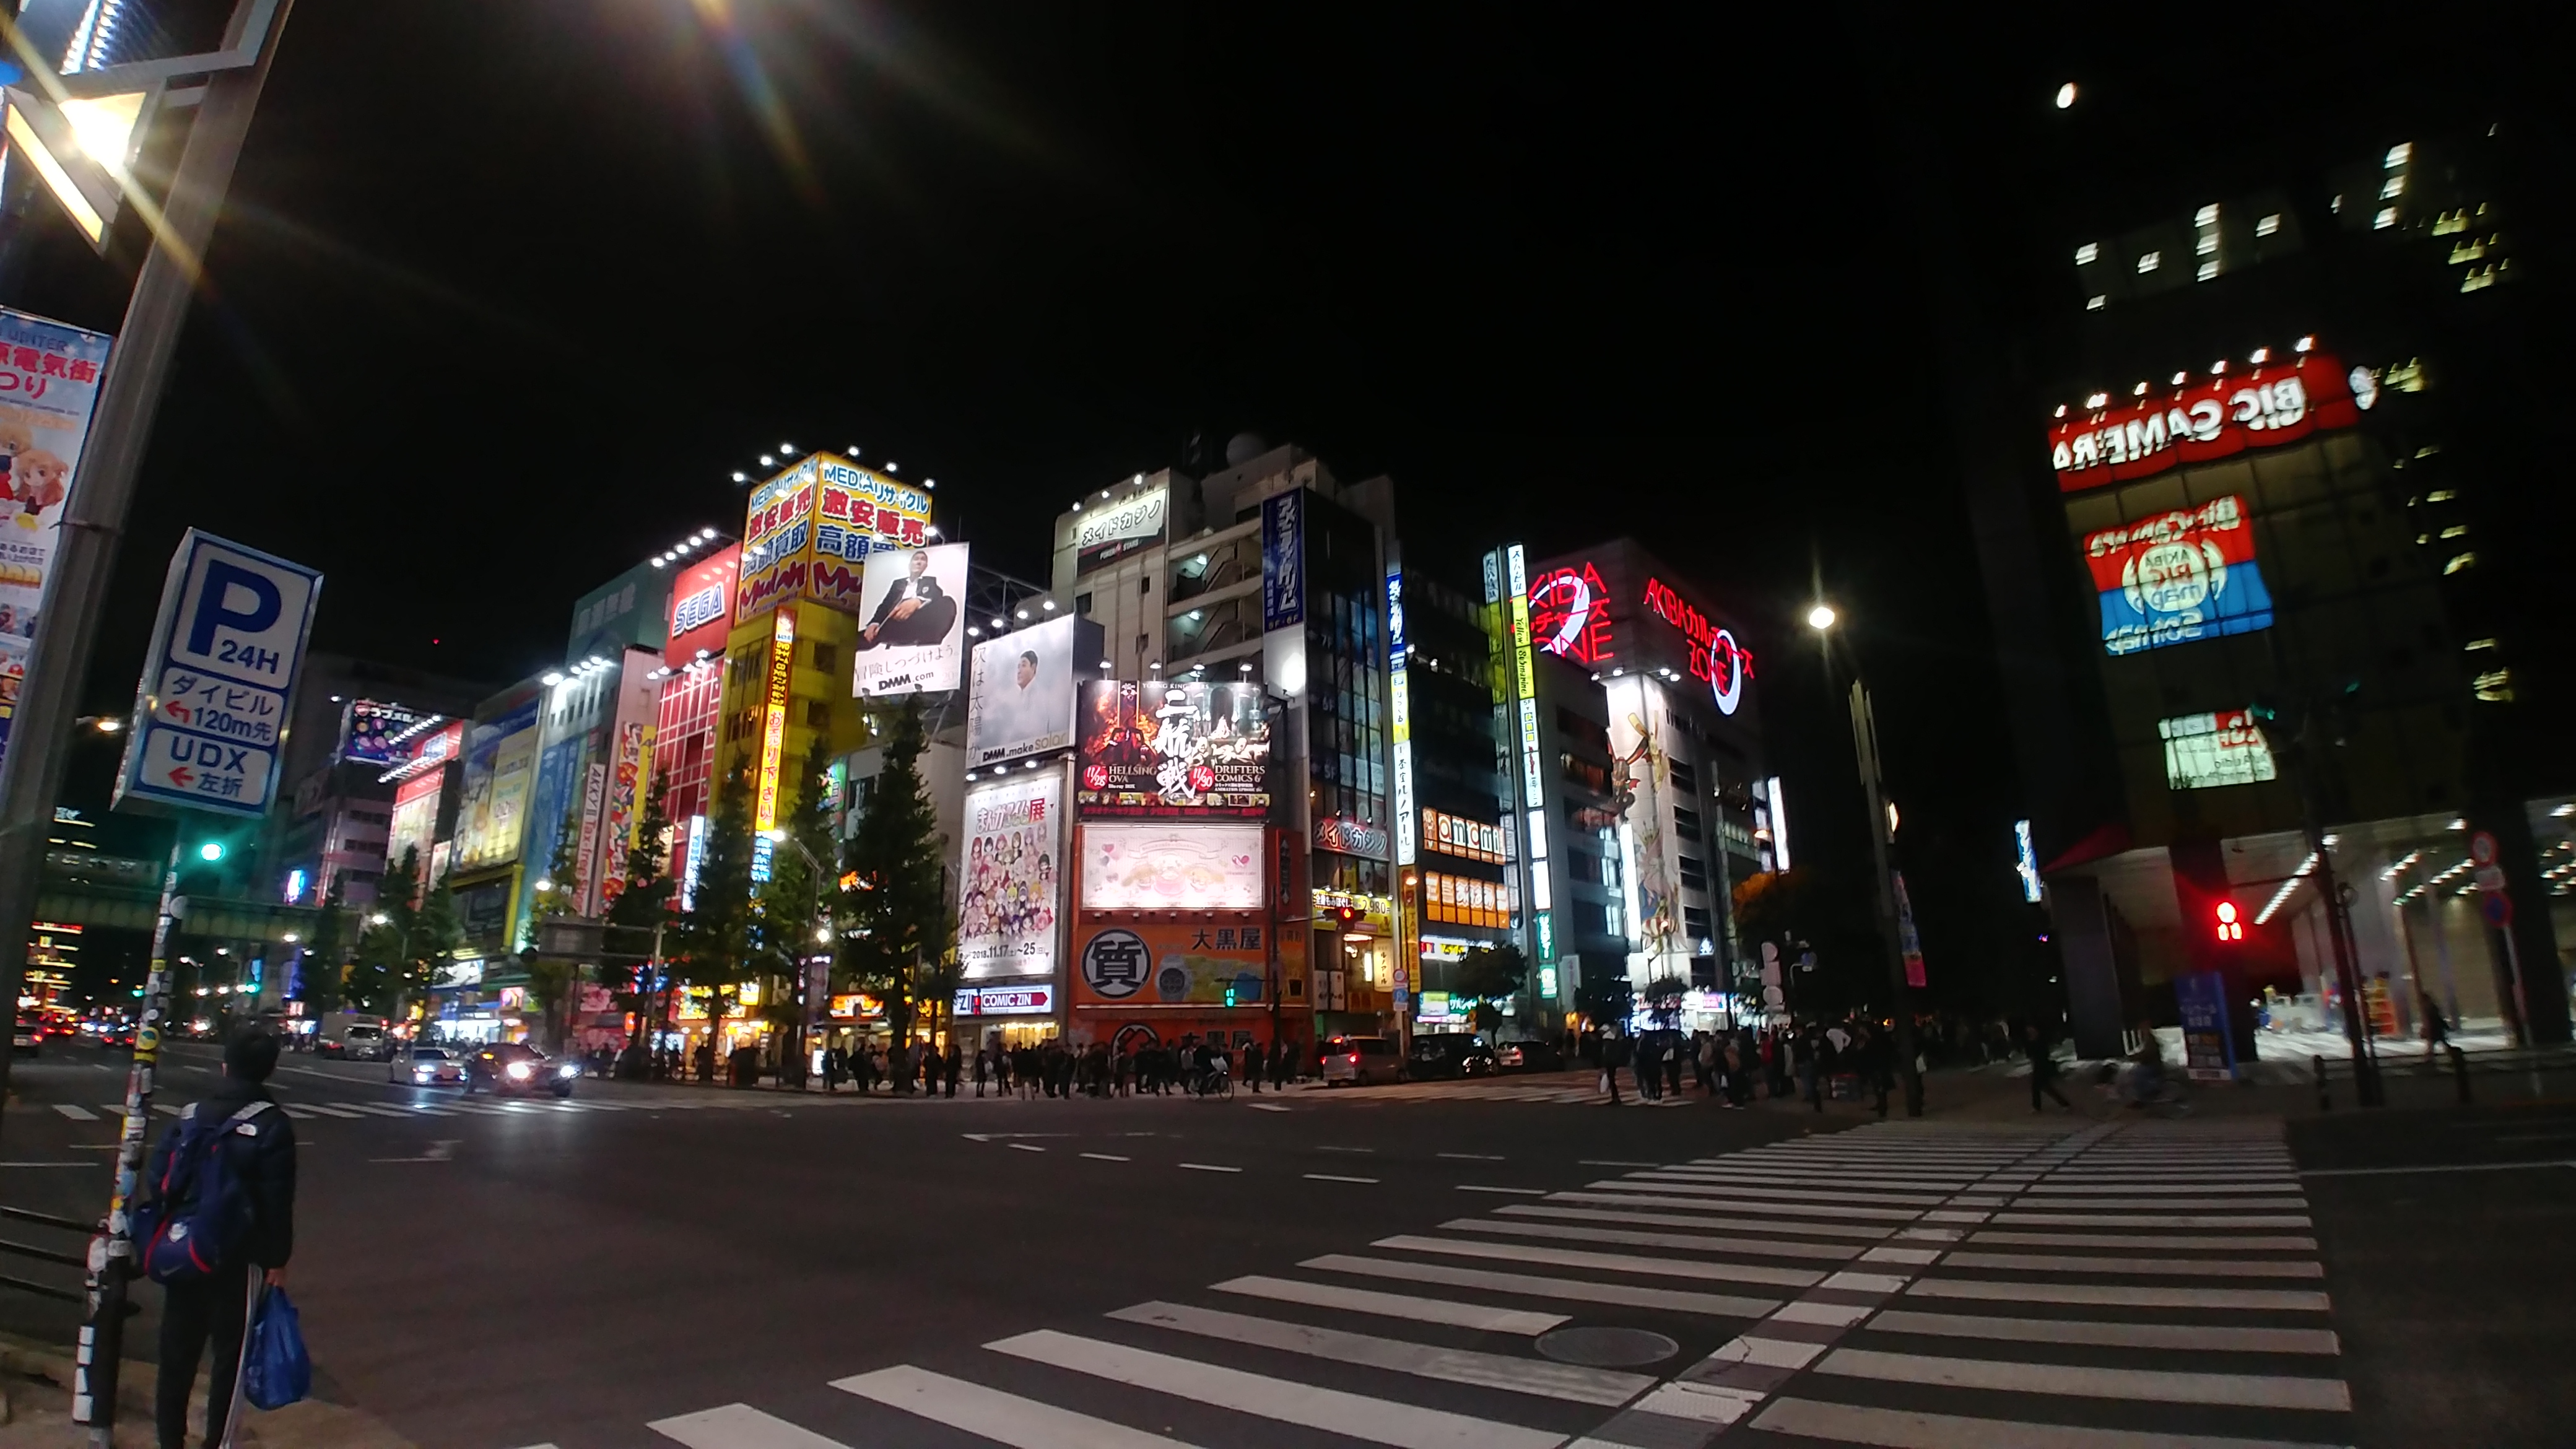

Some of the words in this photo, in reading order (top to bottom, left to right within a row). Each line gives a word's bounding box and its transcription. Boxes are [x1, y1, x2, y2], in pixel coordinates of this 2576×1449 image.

[824, 465, 929, 513] MEDIAリサイクル
[747, 484, 814, 545] 激安販売
[820, 487, 926, 546] 激安販売
[1082, 499, 1161, 546] メイドカジノ
[743, 518, 810, 581] 高額買取
[1528, 562, 1607, 609] KIBA
[187, 560, 281, 656] P
[673, 583, 724, 637] SEGA
[1515, 617, 1525, 644] Yellow
[218, 640, 279, 674] 24H
[1518, 650, 1527, 694] Submarine
[173, 676, 273, 716] ダイビル
[879, 671, 934, 690] DMM.com
[195, 707, 271, 741] 120m先
[968, 647, 986, 767] 次は太陽か。
[170, 736, 248, 773] UDX
[983, 742, 1033, 762] DMM.make
[1035, 731, 1067, 751] solar
[198, 773, 243, 797] 左折
[588, 767, 602, 806] AKKY
[1108, 775, 1129, 783] OVA
[1109, 765, 1157, 775] HELLSING
[1214, 774, 1253, 782] COMICS
[1215, 765, 1266, 774] DRIFTERS
[578, 819, 597, 876] Tax-free
[1315, 821, 1387, 855] メイドカジノ
[1191, 928, 1262, 951] 大黒屋
[1091, 939, 1143, 990] 質
[983, 993, 1016, 1007] COMIC
[1016, 993, 1032, 1006] ZIN
